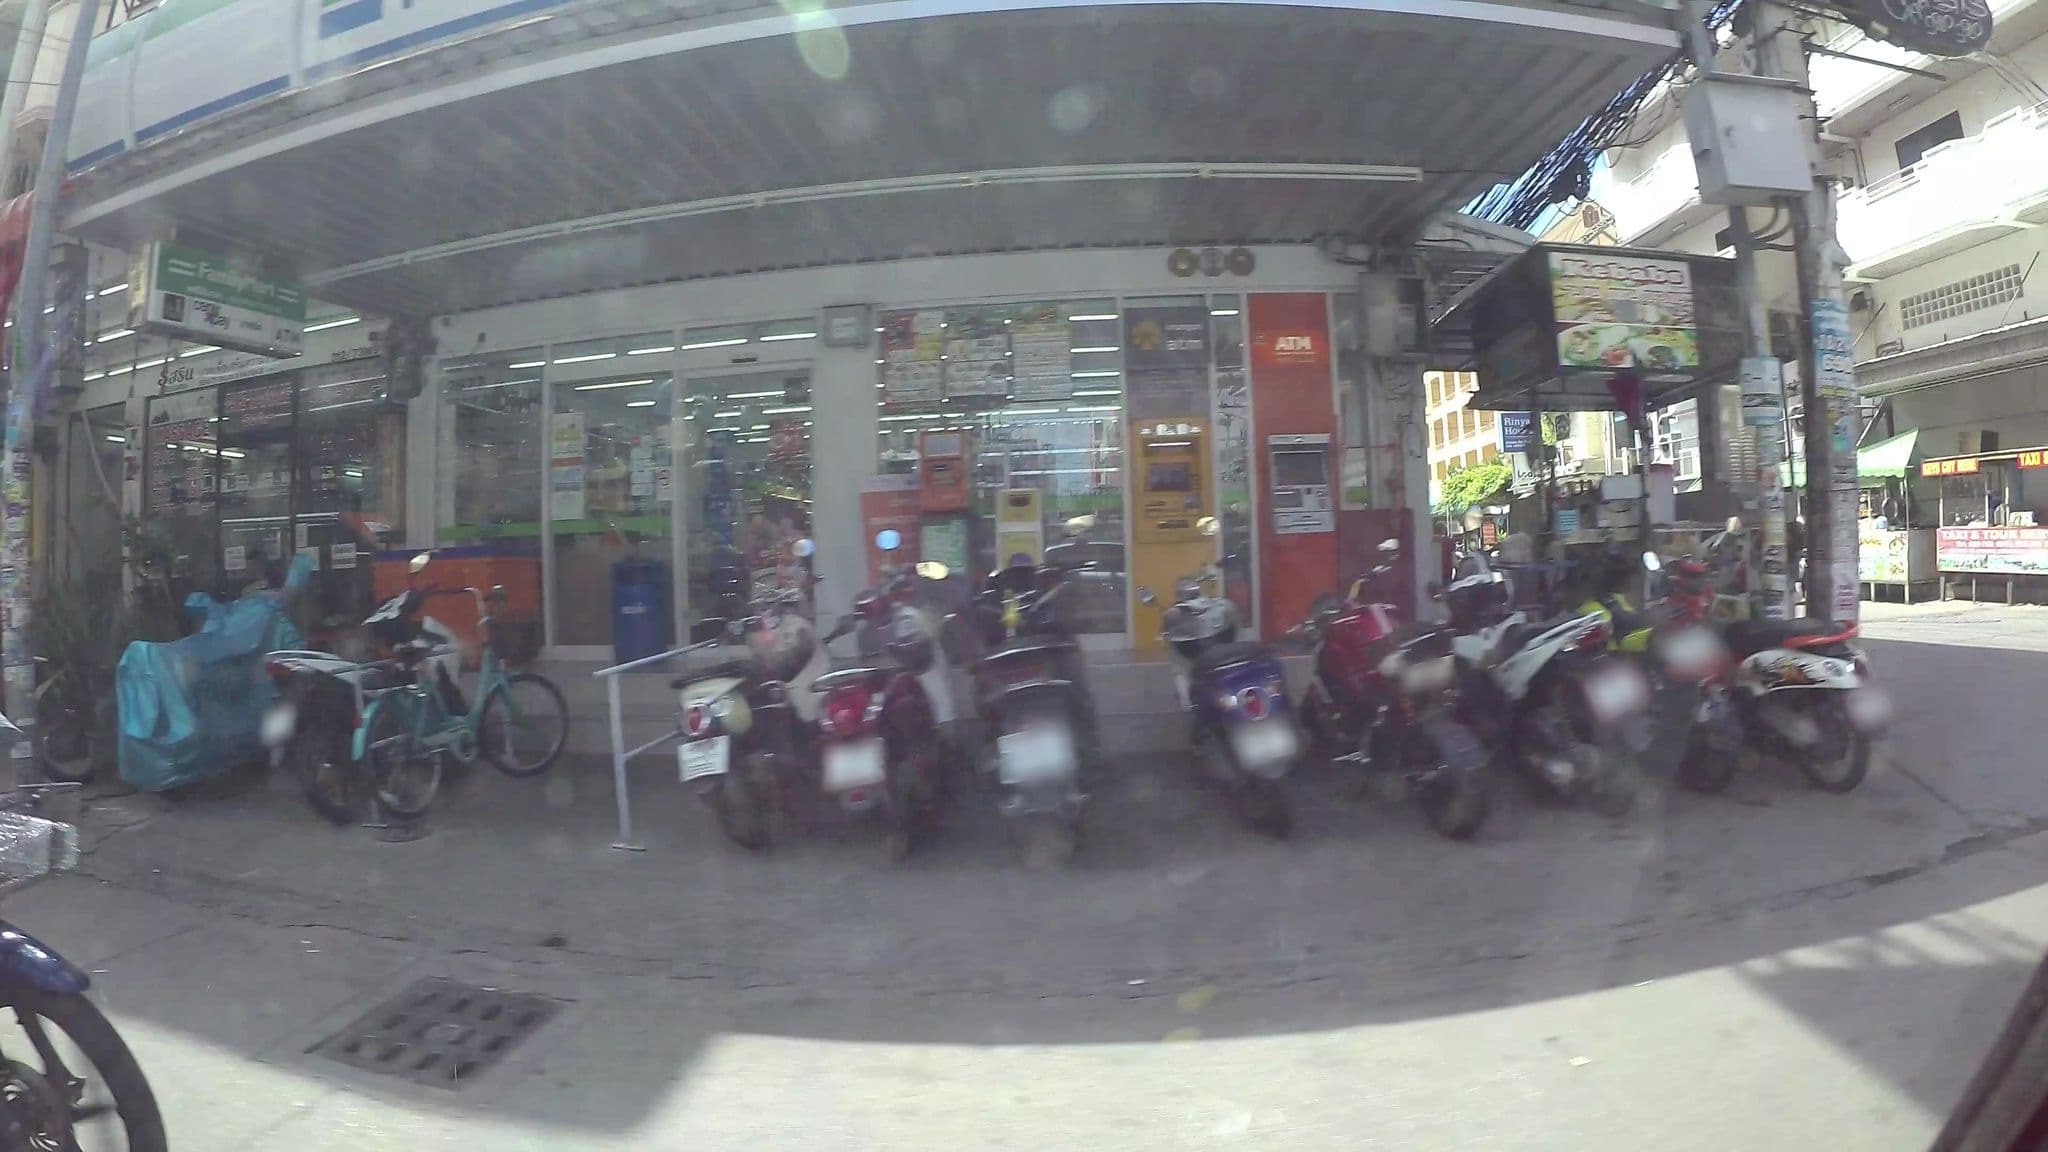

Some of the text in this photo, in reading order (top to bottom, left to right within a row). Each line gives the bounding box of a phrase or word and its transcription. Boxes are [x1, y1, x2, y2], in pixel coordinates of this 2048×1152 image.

[1275, 336, 1312, 351] ATM
[1504, 417, 1531, 427] Rinya
[2019, 452, 2041, 466] TAXI
